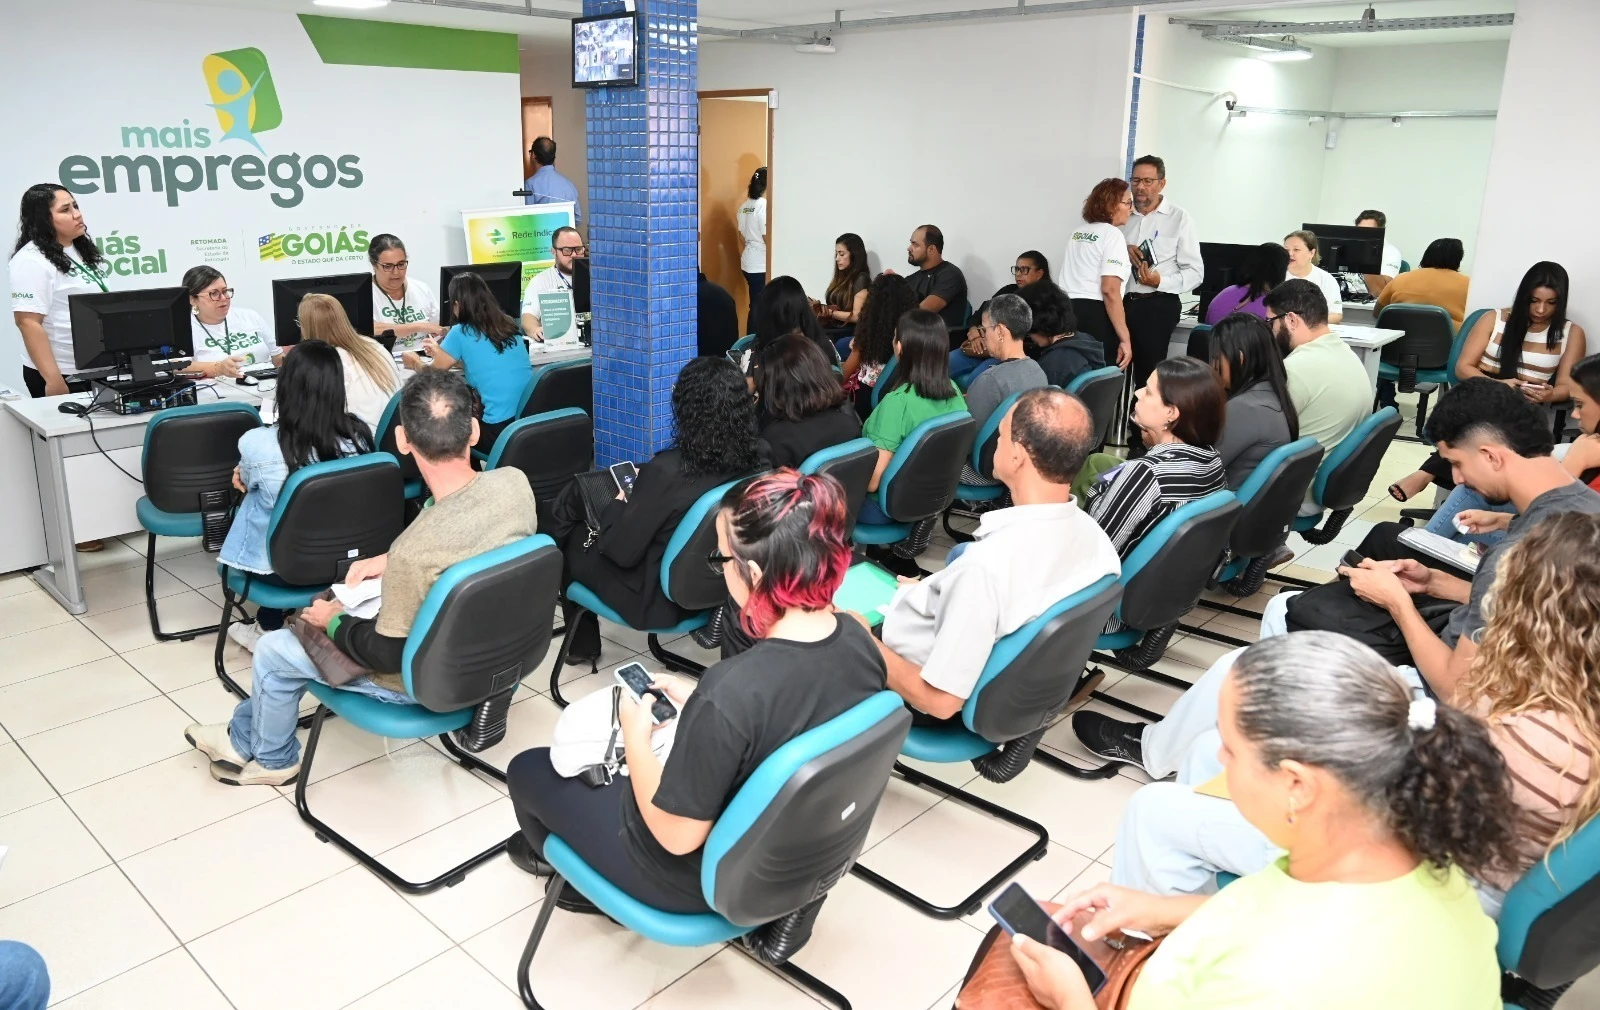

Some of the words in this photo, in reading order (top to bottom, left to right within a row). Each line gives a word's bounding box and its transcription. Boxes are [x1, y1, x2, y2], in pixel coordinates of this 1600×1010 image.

[121, 118, 211, 148] mais
[58, 151, 364, 209] empregos
[281, 225, 370, 257] GOIÁS
[512, 231, 532, 240] Rede
[297, 257, 321, 265] ESTADO
